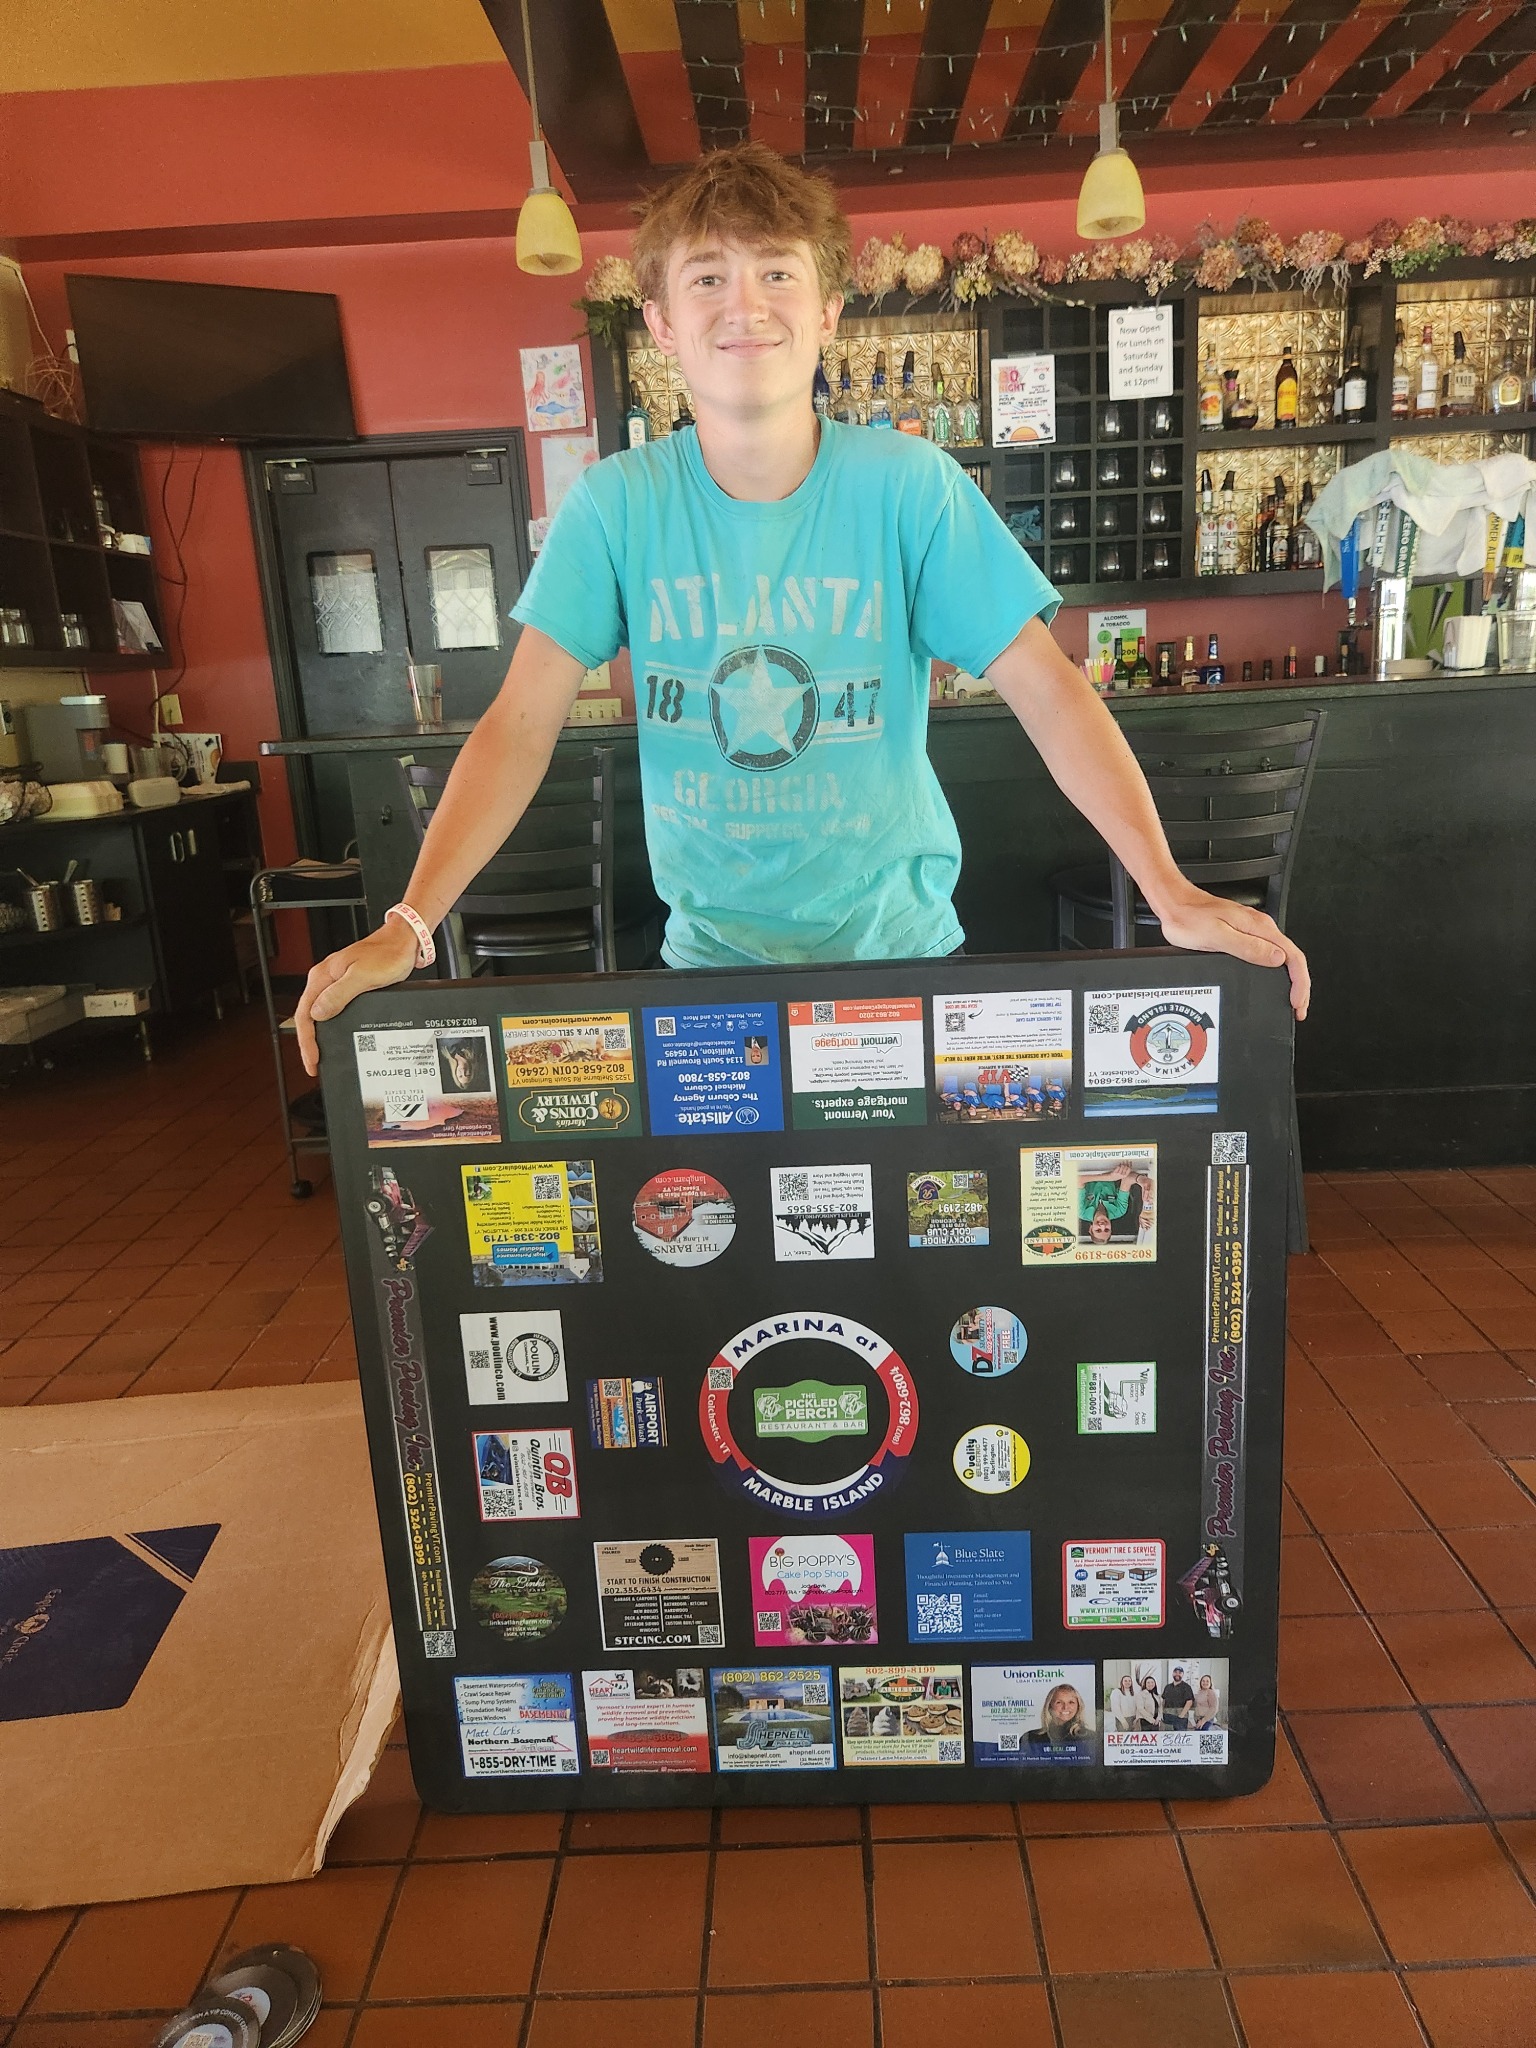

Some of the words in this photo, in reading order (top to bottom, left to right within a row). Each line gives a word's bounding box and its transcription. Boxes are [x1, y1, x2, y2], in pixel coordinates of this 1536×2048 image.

[1139, 325, 1160, 334] Open
[1129, 339, 1151, 347] Lunch
[1123, 352, 1158, 362] Saturday
[1119, 366, 1132, 374] and
[1135, 364, 1163, 373] Sunday
[1134, 377, 1158, 387] 12pm!
[1376, 502, 1390, 554] WHITE
[1400, 515, 1412, 544] ZERO
[1487, 547, 1496, 560] ALE
[649, 573, 882, 642] ATLANTA
[647, 675, 685, 724] 18
[834, 678, 881, 727] 47
[674, 769, 844, 813] GEORGIA
[1091, 987, 1213, 1001] marinamarbleisland.com
[1137, 1004, 1168, 1024] ISLAND
[1170, 1003, 1203, 1023] MARBLE
[424, 1017, 478, 1028] 802.363.7505
[522, 1016, 612, 1026] www.martinscoins.com
[815, 1036, 858, 1048] mortgage
[860, 1036, 898, 1047] vermont
[664, 1049, 687, 1058] 05495
[688, 1049, 698, 1057] VT
[700, 1047, 735, 1056] Williston,
[656, 1058, 667, 1067] Rd
[669, 1057, 701, 1066] Brownell
[703, 1057, 724, 1065] South
[726, 1056, 744, 1064] 1134
[366, 1068, 411, 1079] Barrows
[414, 1067, 436, 1077] Geri
[515, 1066, 549, 1077] (2646)
[552, 1063, 625, 1075] 802-658-COIN
[678, 1070, 750, 1082] 802-658-7800
[978, 1068, 1010, 1084] VIP
[1088, 1076, 1133, 1086] 862-6804
[684, 1084, 718, 1092] Coburn
[720, 1083, 746, 1091] Michael
[385, 1094, 425, 1103] PURSUIT
[535, 1091, 598, 1106] JEWELRY
[673, 1093, 706, 1103] Agency
[708, 1093, 739, 1102] Coburn
[741, 1093, 758, 1101] The
[811, 1096, 855, 1109] experts.
[857, 1094, 908, 1108] mortgage
[531, 1108, 549, 1122] &
[549, 1106, 598, 1119] COINS
[678, 1110, 734, 1125] Allstate
[824, 1110, 868, 1121] Vermont
[870, 1109, 895, 1120] Your
[1069, 1149, 1149, 1159] PalmerLaneMaple.com
[482, 1163, 553, 1172] www.HPModular2.com
[655, 1174, 707, 1185] langbarn.com
[787, 1203, 858, 1213] 802-355-8565
[938, 1203, 983, 1212] 482-2191
[927, 1228, 948, 1236] CLUB
[949, 1227, 971, 1236] GOLF
[483, 1232, 560, 1243] 802-338-1719
[922, 1237, 948, 1245] RIDGE
[950, 1235, 976, 1244] ROCKY
[654, 1244, 693, 1254] BARNS
[696, 1243, 720, 1253] THE
[1075, 1249, 1152, 1260] 802-899-8199
[1231, 1242, 1242, 1305] 524-0399
[1211, 1243, 1223, 1343] PremierPavingVT.com
[382, 1279, 413, 1357] Premier
[1230, 1308, 1243, 1343] (802)
[732, 1318, 845, 1358] MARINA
[856, 1335, 878, 1352] at
[1002, 1330, 1010, 1349] FREE
[489, 1317, 506, 1400] www.poulinco.com
[530, 1340, 540, 1374] POULIN
[1208, 1345, 1237, 1383] Inc.
[393, 1361, 424, 1430] Paving
[889, 1365, 911, 1425] 862-6804
[784, 1398, 838, 1409] PICKLED
[644, 1393, 659, 1444] AIRPORT
[785, 1407, 838, 1420] PERCH
[707, 1393, 721, 1440] Colchester,
[720, 1442, 731, 1454] VT
[760, 1422, 828, 1430] RESTAURANT
[1208, 1388, 1243, 1459] Paving
[638, 1423, 646, 1442] Wash
[892, 1425, 905, 1445] (802)
[404, 1434, 433, 1471] Inc.
[529, 1438, 543, 1482] Quintin
[963, 1439, 977, 1479] Quality
[544, 1452, 572, 1498] QB
[404, 1472, 418, 1505] (802)
[743, 1476, 813, 1512] MARBLE
[822, 1472, 884, 1511] ISLAND
[535, 1484, 545, 1511] Bros.
[1205, 1462, 1234, 1536] Premier
[424, 1473, 443, 1564] PremierPavingVT.com
[409, 1509, 425, 1565] 524-0399
[955, 1549, 976, 1559] Blue
[978, 1548, 1005, 1559] Slate
[1085, 1547, 1112, 1555] VERMONT
[769, 1553, 794, 1568] BIG
[798, 1554, 856, 1567] POPPY'S
[777, 1570, 801, 1579] Cake
[804, 1570, 822, 1579] Pop
[824, 1569, 849, 1578] Shop
[489, 1577, 510, 1588] The
[512, 1577, 545, 1589] Links
[661, 1576, 711, 1584] CONSTRUCTION
[604, 1586, 662, 1595] 802.355.6434
[615, 1635, 692, 1645] STFCINC.COM
[865, 1666, 936, 1675] 802-899-8199
[1003, 1669, 1065, 1680] UnionBank
[722, 1671, 755, 1684] (802)
[760, 1670, 821, 1683] 862-2525
[1008, 1699, 1034, 1707] FARRELL
[468, 1737, 509, 1745] Northern
[510, 1735, 554, 1744] Basement
[744, 1719, 811, 1750] SHEPNELL
[1108, 1733, 1158, 1744] RE/MAX
[1163, 1733, 1191, 1745] Elite
[612, 1745, 697, 1754] heartwildliferemoval.com
[470, 1755, 557, 1769] 1-855-DRY-TIME
